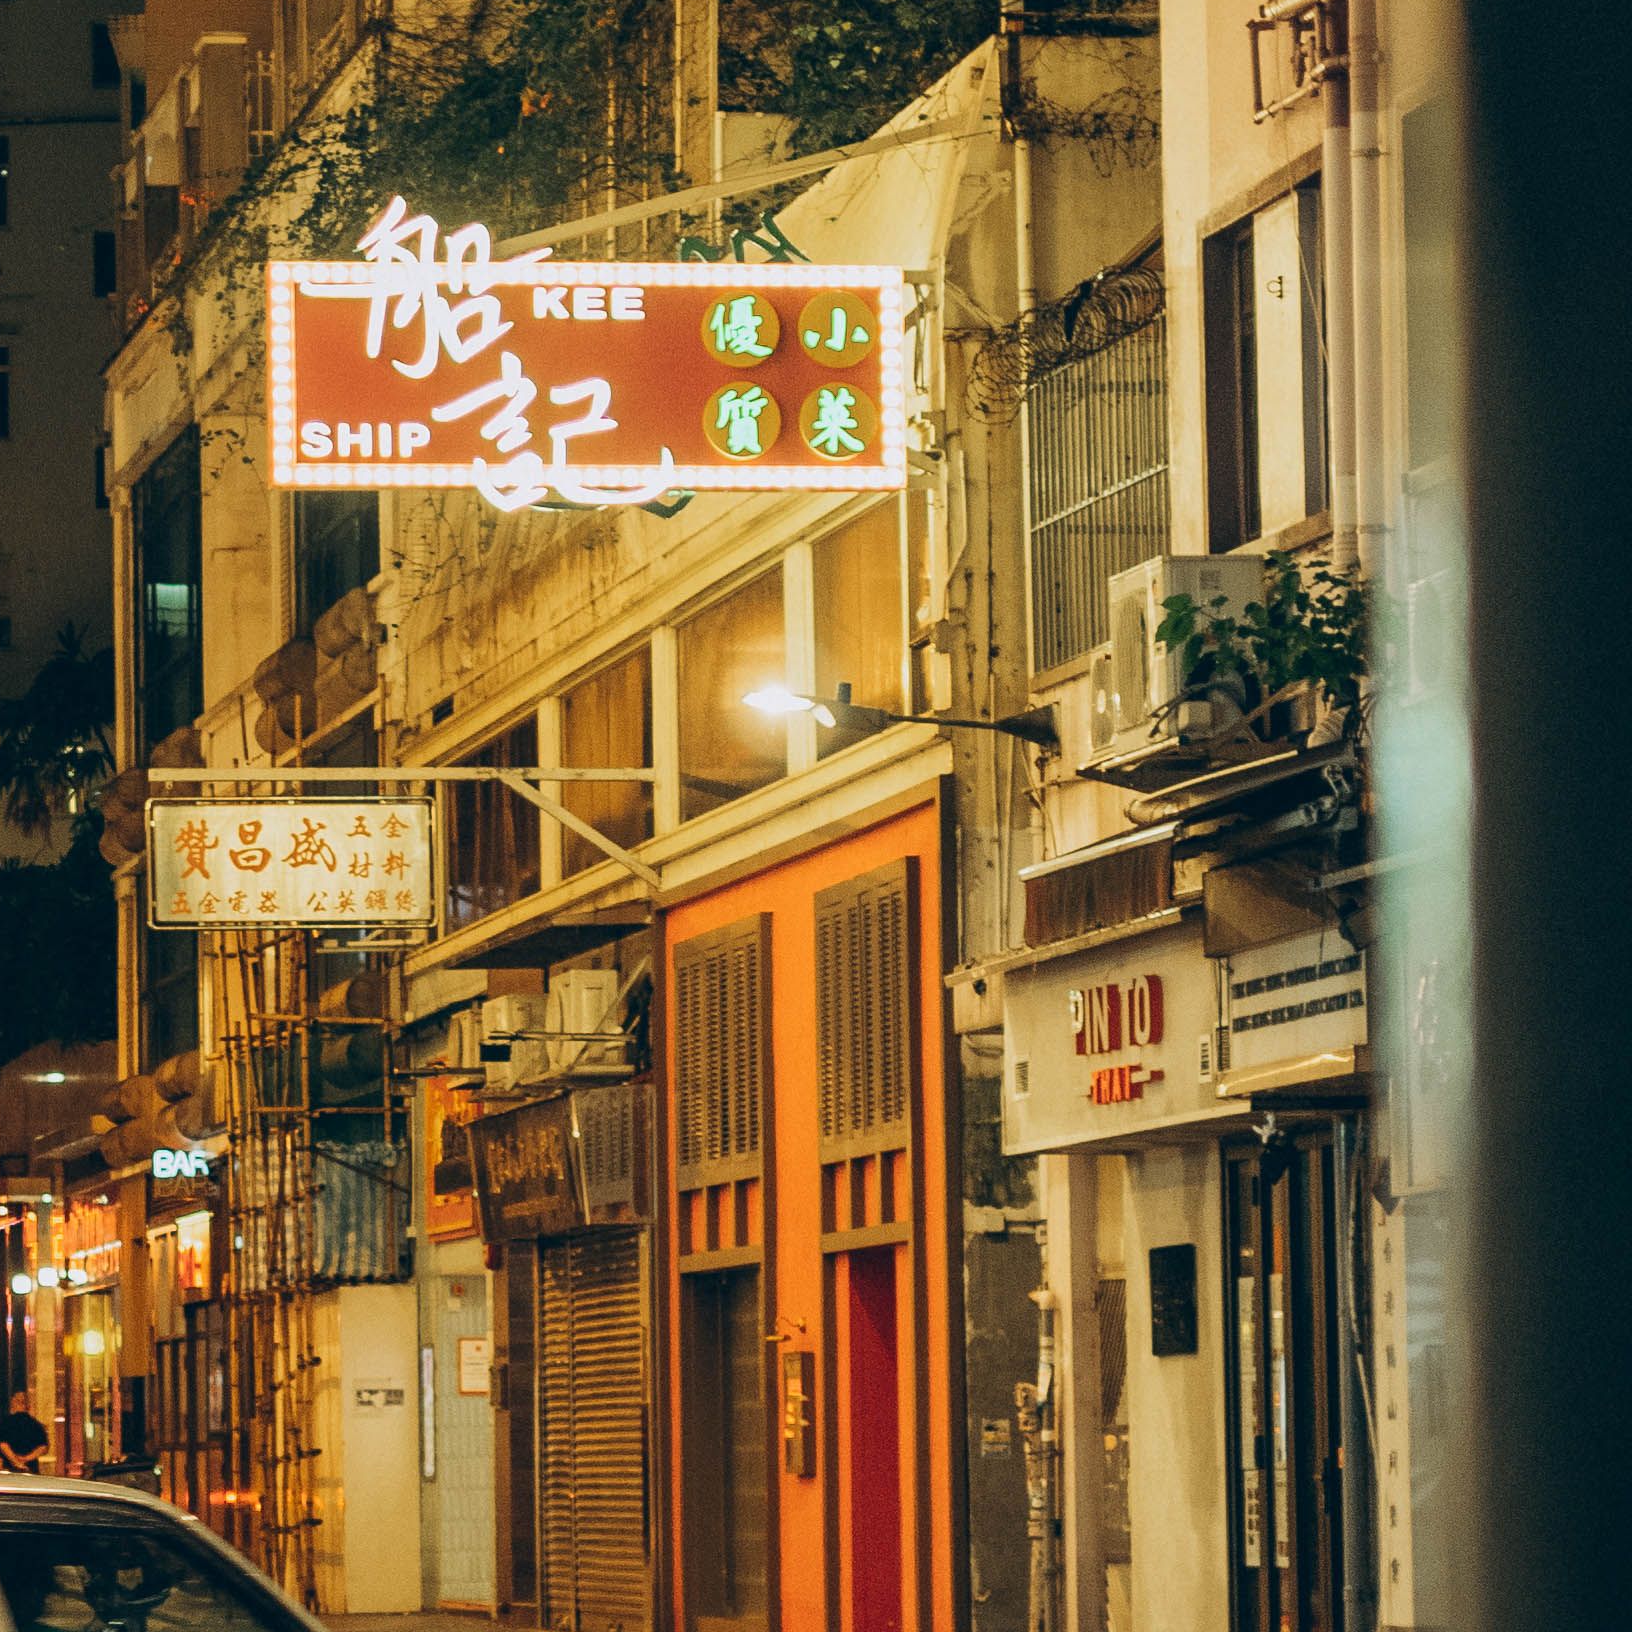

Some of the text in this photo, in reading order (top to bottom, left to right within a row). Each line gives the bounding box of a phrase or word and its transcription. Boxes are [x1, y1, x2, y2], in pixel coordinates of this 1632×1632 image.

[532, 287, 647, 321] KEE
[301, 422, 431, 458] SHIP
[152, 1148, 210, 1178] BAR
